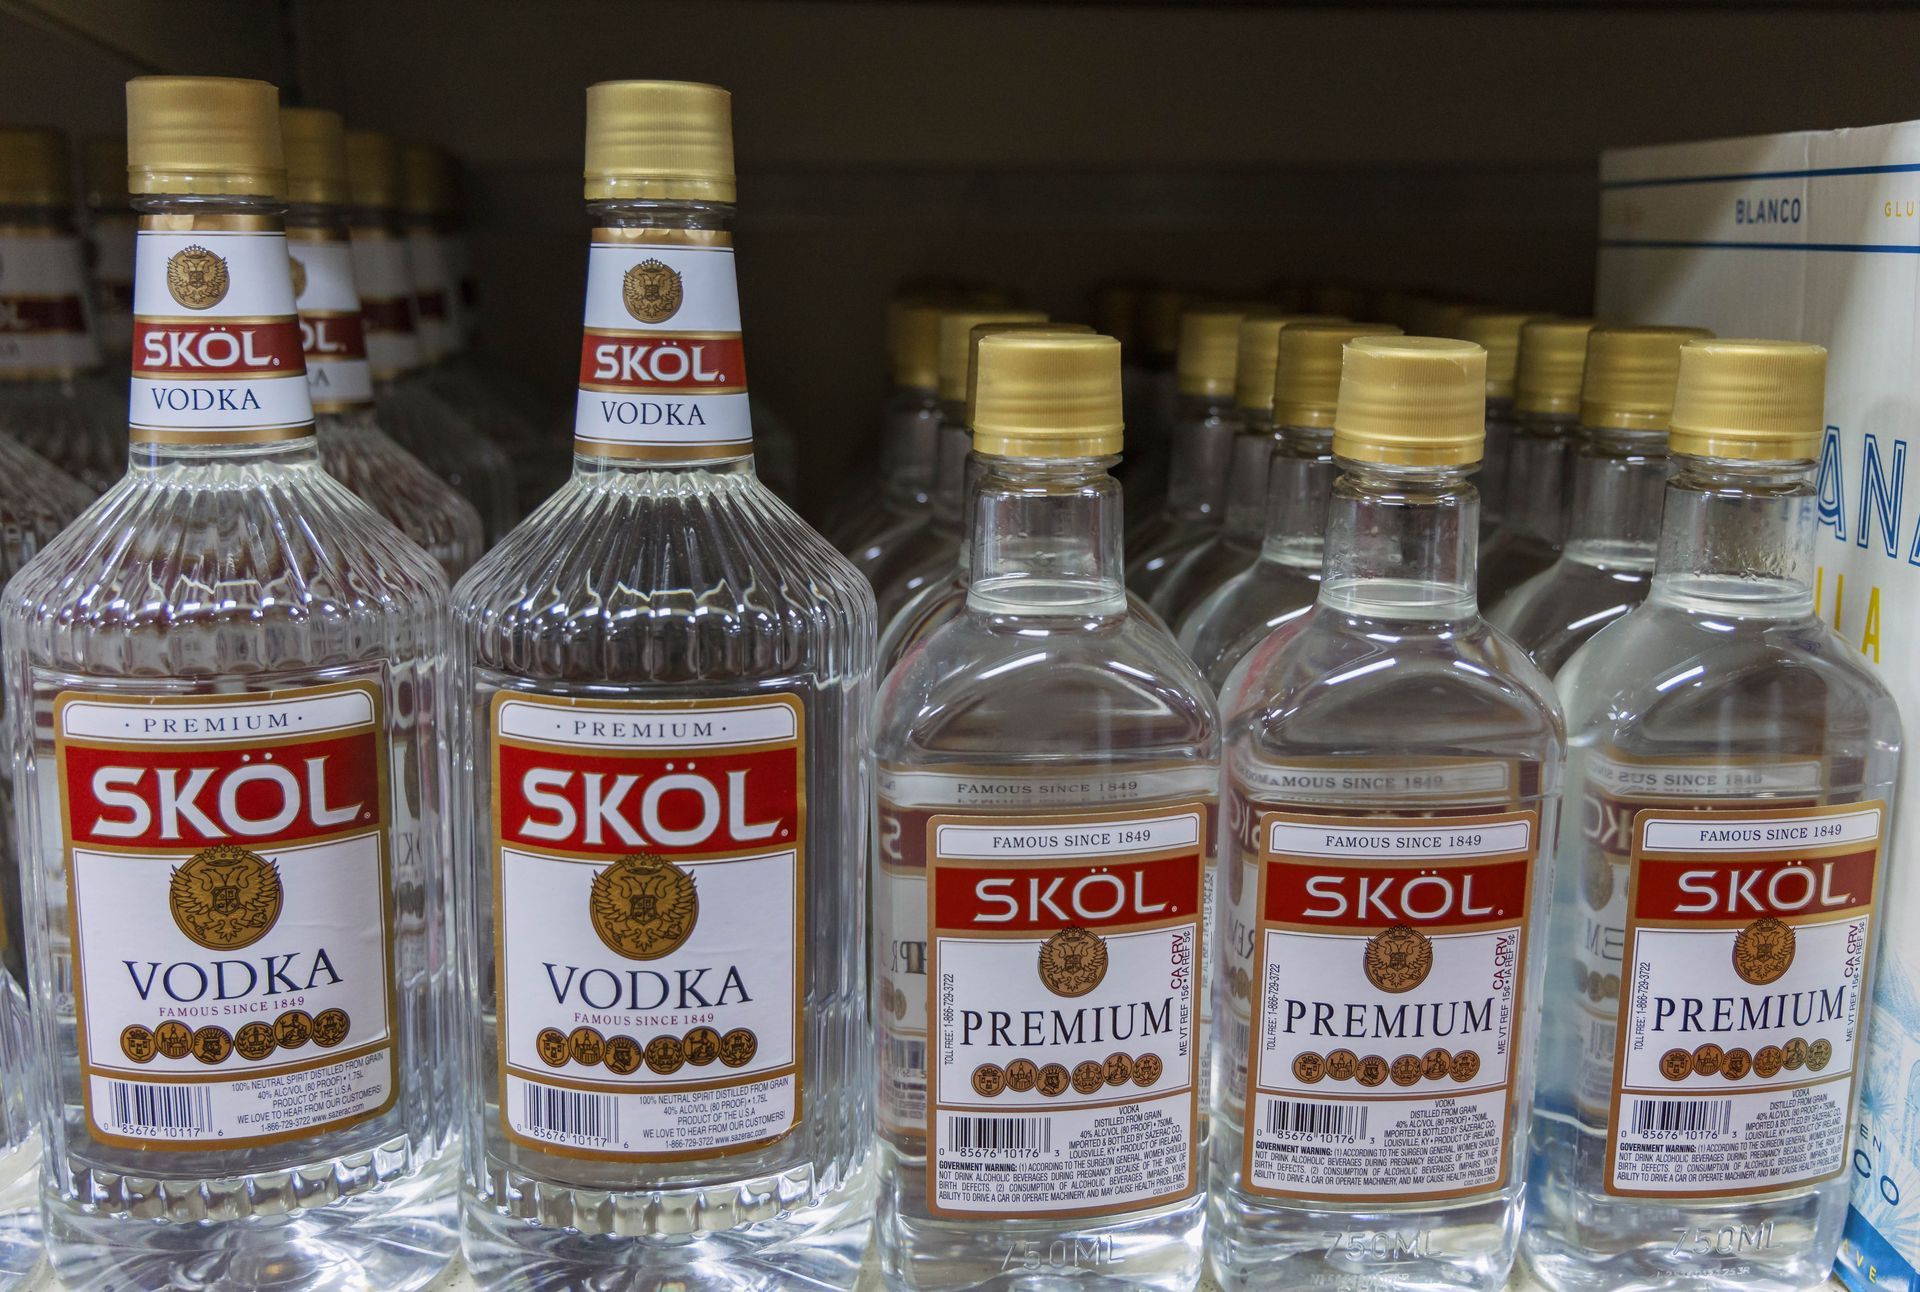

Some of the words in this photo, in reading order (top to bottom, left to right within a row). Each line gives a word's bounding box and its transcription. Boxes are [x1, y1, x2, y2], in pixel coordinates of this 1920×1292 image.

[1736, 199, 1800, 224] BLANCO
[144, 327, 272, 367] SKÖL
[594, 341, 719, 381] SKÖL
[152, 388, 261, 411] VODKA
[601, 401, 706, 425] VODKA
[144, 712, 288, 732] PREMIUM
[574, 720, 712, 738] PREMIUM
[91, 753, 362, 839] SKÖL
[519, 762, 783, 847] SKÖL
[993, 836, 1058, 848] FAMOUS
[1065, 834, 1110, 847] SINCE
[1118, 830, 1151, 843] 1849
[1326, 836, 1390, 848] FAMOUS
[1396, 837, 1442, 848] SINCE
[1449, 835, 1482, 847] 1849
[1700, 830, 1761, 841] FAMOUS
[1767, 828, 1807, 840] SINCE
[1814, 824, 1842, 837] 1849
[973, 867, 1168, 922] SKÖL
[1302, 870, 1495, 919] SKÖL
[1674, 860, 1851, 912] SKÖL
[1172, 935, 1184, 965] CRV
[1847, 925, 1858, 954] CRV
[1495, 937, 1508, 966] CRV
[122, 948, 343, 1002] VODKA
[1844, 957, 1854, 977] CA
[542, 962, 753, 1010] VODKA
[1171, 967, 1182, 989] CA
[1493, 969, 1505, 990] CA
[1636, 962, 1650, 1014] 1-866-729-3722
[1268, 964, 1280, 1015] 1-866-729-3722
[159, 1006, 219, 1017] FAMOUS
[224, 1002, 267, 1015] SINCE
[274, 997, 305, 1010] 1849
[944, 974, 953, 1027] 1-866-729-3722
[1652, 985, 1846, 1032] PREMIUM
[574, 1012, 631, 1025] FAMOUS
[636, 1016, 678, 1026] SINCE
[684, 1013, 714, 1024] 1849
[960, 997, 1173, 1046] PREMIUM
[1283, 997, 1495, 1038] PREMIUM
[1180, 1027, 1188, 1039] VT
[1267, 1037, 1276, 1050] TOLL
[1634, 1036, 1644, 1050] TOLL
[945, 1050, 953, 1065] TOLL
[1179, 1041, 1187, 1056] ME
[232, 1081, 250, 1091] 100%
[252, 1078, 284, 1089] NEUTRAL
[287, 1072, 308, 1085] SPIRIT
[311, 1065, 343, 1079] DISTILLED
[345, 1060, 364, 1071] FROM
[365, 1052, 383, 1065] GRAIN
[274, 1085, 302, 1097] ALC/VOL
[305, 1083, 315, 1093] (80
[317, 1075, 342, 1090] PROOF)
[348, 1071, 363, 1080] 1.75L
[640, 1096, 657, 1104] 100%
[659, 1095, 690, 1104] NEUTRAL
[692, 1092, 713, 1103] SPIRIT
[716, 1087, 748, 1100] DISTILLED
[751, 1083, 768, 1093] FROM
[770, 1077, 788, 1089] GRAIN
[1792, 1088, 1810, 1098] VODKA
[273, 1096, 307, 1108] PRODUCT
[309, 1092, 319, 1101] OF
[321, 1089, 332, 1098] THE
[664, 1107, 678, 1115] 40%
[679, 1104, 708, 1114] ALC/VOL
[710, 1102, 720, 1111] (80
[722, 1098, 747, 1110] PROOF)
[752, 1095, 767, 1103] 1.75L
[1435, 1099, 1455, 1107] VODKA
[237, 1115, 249, 1124] WE
[251, 1111, 271, 1123] LOVE
[272, 1110, 281, 1119] TO
[283, 1107, 302, 1117] HEAR
[305, 1103, 324, 1114] FROM
[326, 1098, 340, 1108] OUR
[261, 1115, 310, 1131] 1-866-729-3722
[312, 1103, 364, 1123] www.sazerac.com
[678, 1114, 711, 1125] PRODUCT
[713, 1113, 722, 1122] OF
[724, 1111, 736, 1120] THE
[1095, 1116, 1124, 1128] DISTILLED
[1126, 1114, 1143, 1124] FROM
[1144, 1110, 1162, 1120] GRAIN
[1119, 1105, 1139, 1115] VODKA
[122, 1124, 156, 1136] 85676
[164, 1128, 200, 1137] 10117
[643, 1128, 654, 1138] WE
[656, 1128, 674, 1137] LOVE
[677, 1127, 686, 1137] TO
[688, 1126, 706, 1136] HEAR
[708, 1123, 727, 1133] FROM
[730, 1121, 743, 1130] OUR
[745, 1111, 785, 1128] CUSTOMERS!
[1643, 1131, 1677, 1139] 85676
[1685, 1131, 1717, 1139] 10176
[534, 1127, 565, 1142] 85676
[573, 1135, 607, 1147] 10117
[666, 1136, 713, 1148] 1-866-729-3722
[715, 1128, 767, 1144] www.sazerac.com
[1277, 1131, 1312, 1141] 85676
[1321, 1134, 1354, 1144] 10176
[1620, 1143, 1664, 1152] GOVERNMENT
[961, 1149, 996, 1158] 85676
[1004, 1149, 1038, 1158] 10176
[1256, 1141, 1299, 1153] GOVERNMENT
[1301, 1147, 1332, 1155] WARNING:
[939, 1161, 982, 1171] GOVERNMENT
[985, 1164, 1017, 1172] WARNING:
[1323, 1231, 1442, 1261] 750ML
